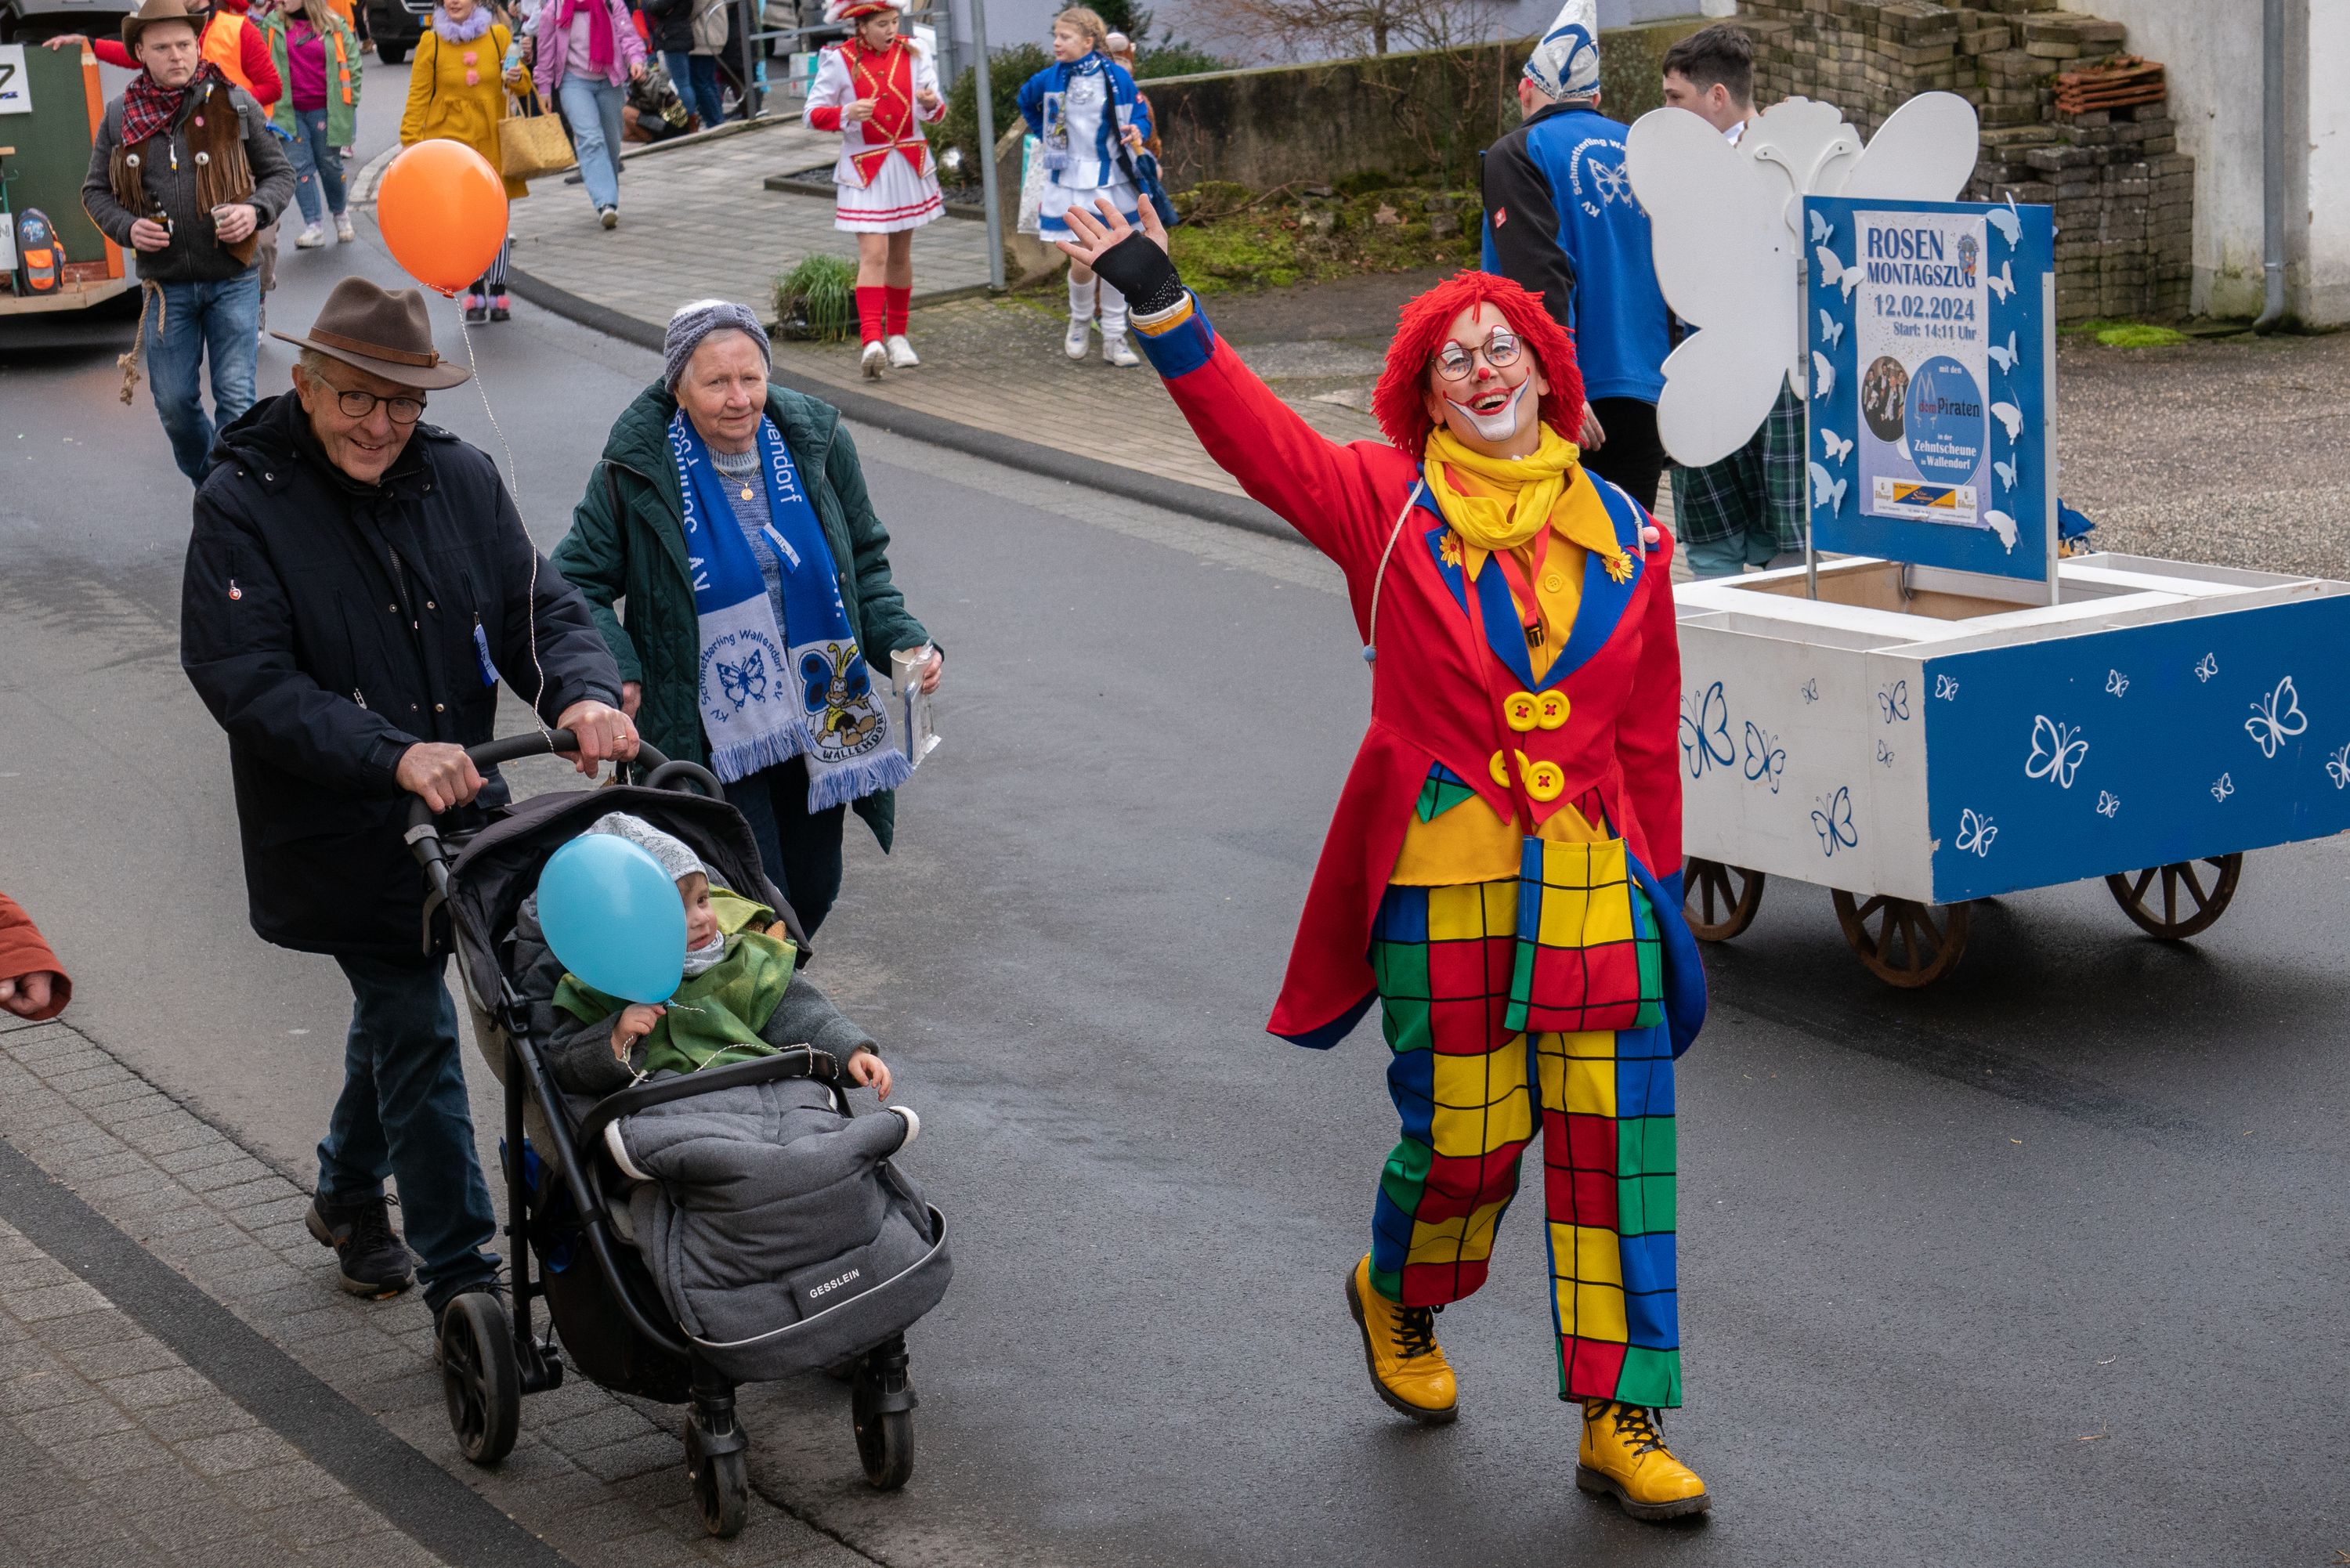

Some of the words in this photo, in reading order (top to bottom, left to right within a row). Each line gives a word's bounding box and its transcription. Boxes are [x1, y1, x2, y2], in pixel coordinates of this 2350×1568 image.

[1867, 227, 1943, 261] ROSEN
[1867, 262, 1976, 288] MONTAGSZUG
[1875, 294, 1975, 321] 12.02.2024
[1893, 321, 1920, 336] Start:
[1925, 323, 1953, 338] 14:11
[1958, 324, 1977, 340] Uhr
[1914, 439, 1976, 457] Zehntscheune
[1927, 455, 1971, 470] Wallendorf
[809, 1268, 860, 1298] GESSLEIN
